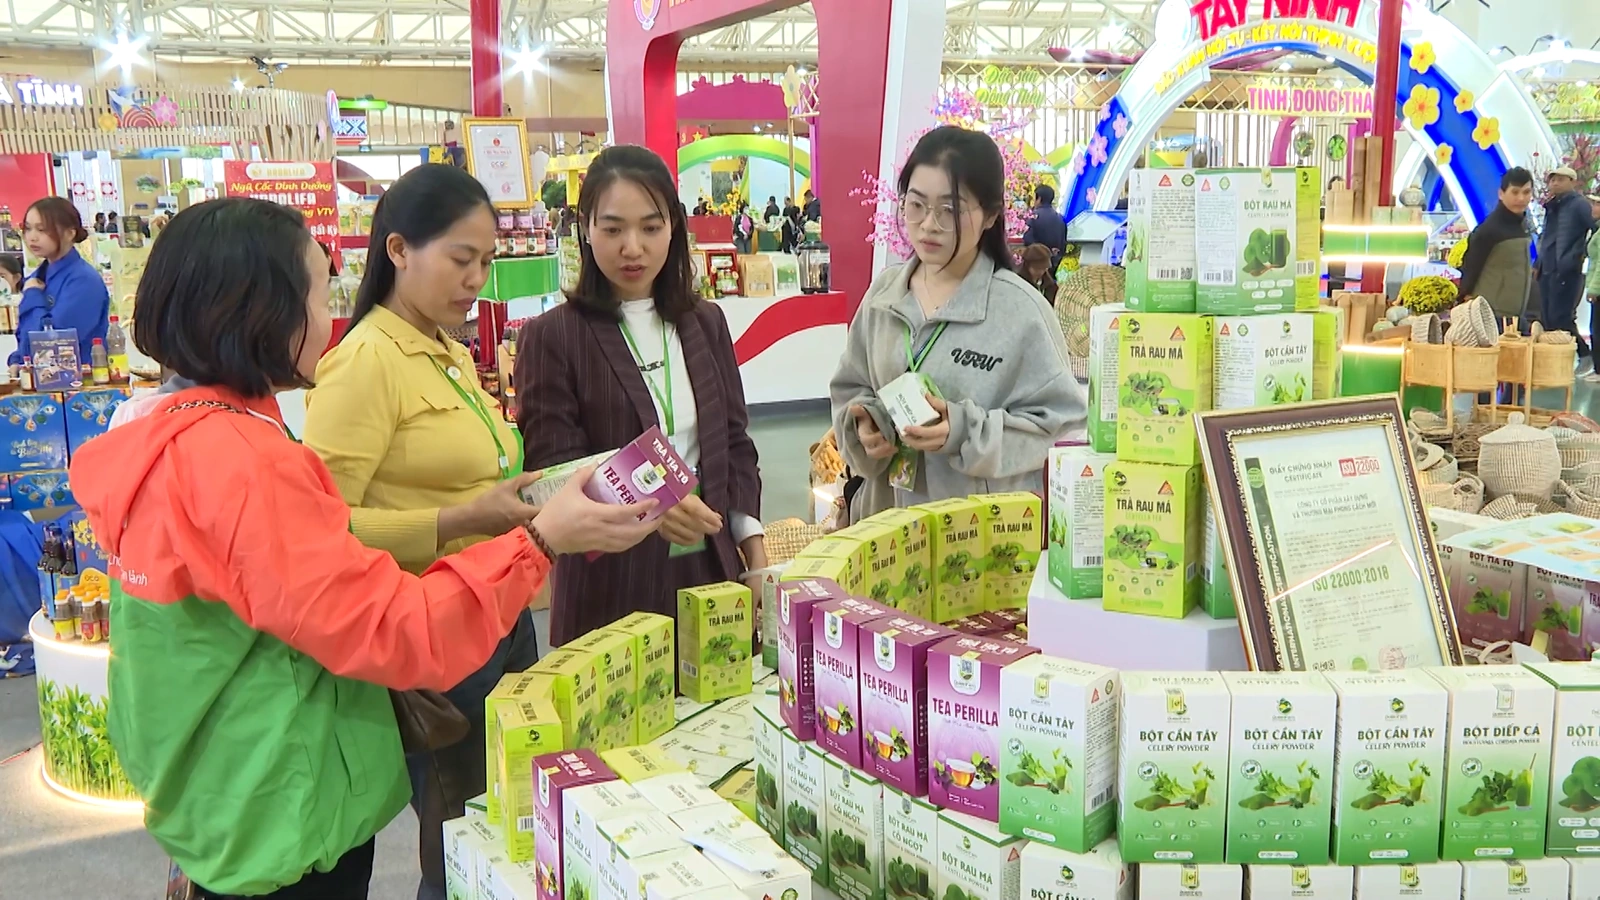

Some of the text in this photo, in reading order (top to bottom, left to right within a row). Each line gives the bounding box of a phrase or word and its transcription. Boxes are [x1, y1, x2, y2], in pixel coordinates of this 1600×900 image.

[1252, 20, 1276, 42] KẾT
[1280, 18, 1303, 40] NỐI
[1306, 25, 1345, 49] THỊNH
[17, 78, 84, 106] TĨNH
[316, 207, 335, 216] VTV
[1263, 201, 1279, 210] RAU
[1130, 344, 1183, 359] TRÀ RAU MÁ
[1288, 462, 1313, 473] CHỨNG
[1355, 459, 1380, 473] 22000
[603, 466, 620, 486] TEA
[1284, 472, 1323, 483] CERTIFICATE
[1117, 497, 1171, 514] TRÀ RAU MÁ
[993, 523, 1005, 534] TRÀ
[1007, 523, 1020, 532] RAU
[1312, 564, 1389, 592] ISO 22000:2018
[709, 616, 720, 627] TRÀ
[815, 649, 854, 680] TEA PERILLA
[863, 672, 908, 704] TEA PERILLA
[932, 698, 999, 727] TEA PERILLA
[1009, 706, 1028, 720] BỘT
[1055, 716, 1074, 730] TÂY
[1039, 728, 1067, 739] POWDER
[1139, 729, 1164, 743] BỘT
[1196, 728, 1219, 742] TÂY
[1244, 728, 1269, 741] BỘT
[1301, 727, 1323, 740] TÂY
[1357, 728, 1382, 743] BỘT
[1412, 725, 1435, 739] TÂY
[1463, 725, 1490, 740] BỘT
[1493, 723, 1520, 737] DIẾP
[1567, 723, 1594, 738] BỘT
[1147, 744, 1210, 752] CELERY POWDER
[1252, 743, 1280, 751] CELERY
[1365, 741, 1426, 750] CELERY POWDER
[901, 824, 915, 837] RAU
[942, 850, 958, 867] BỘT
[960, 860, 977, 877] RAU
[979, 870, 993, 885] MÁ
